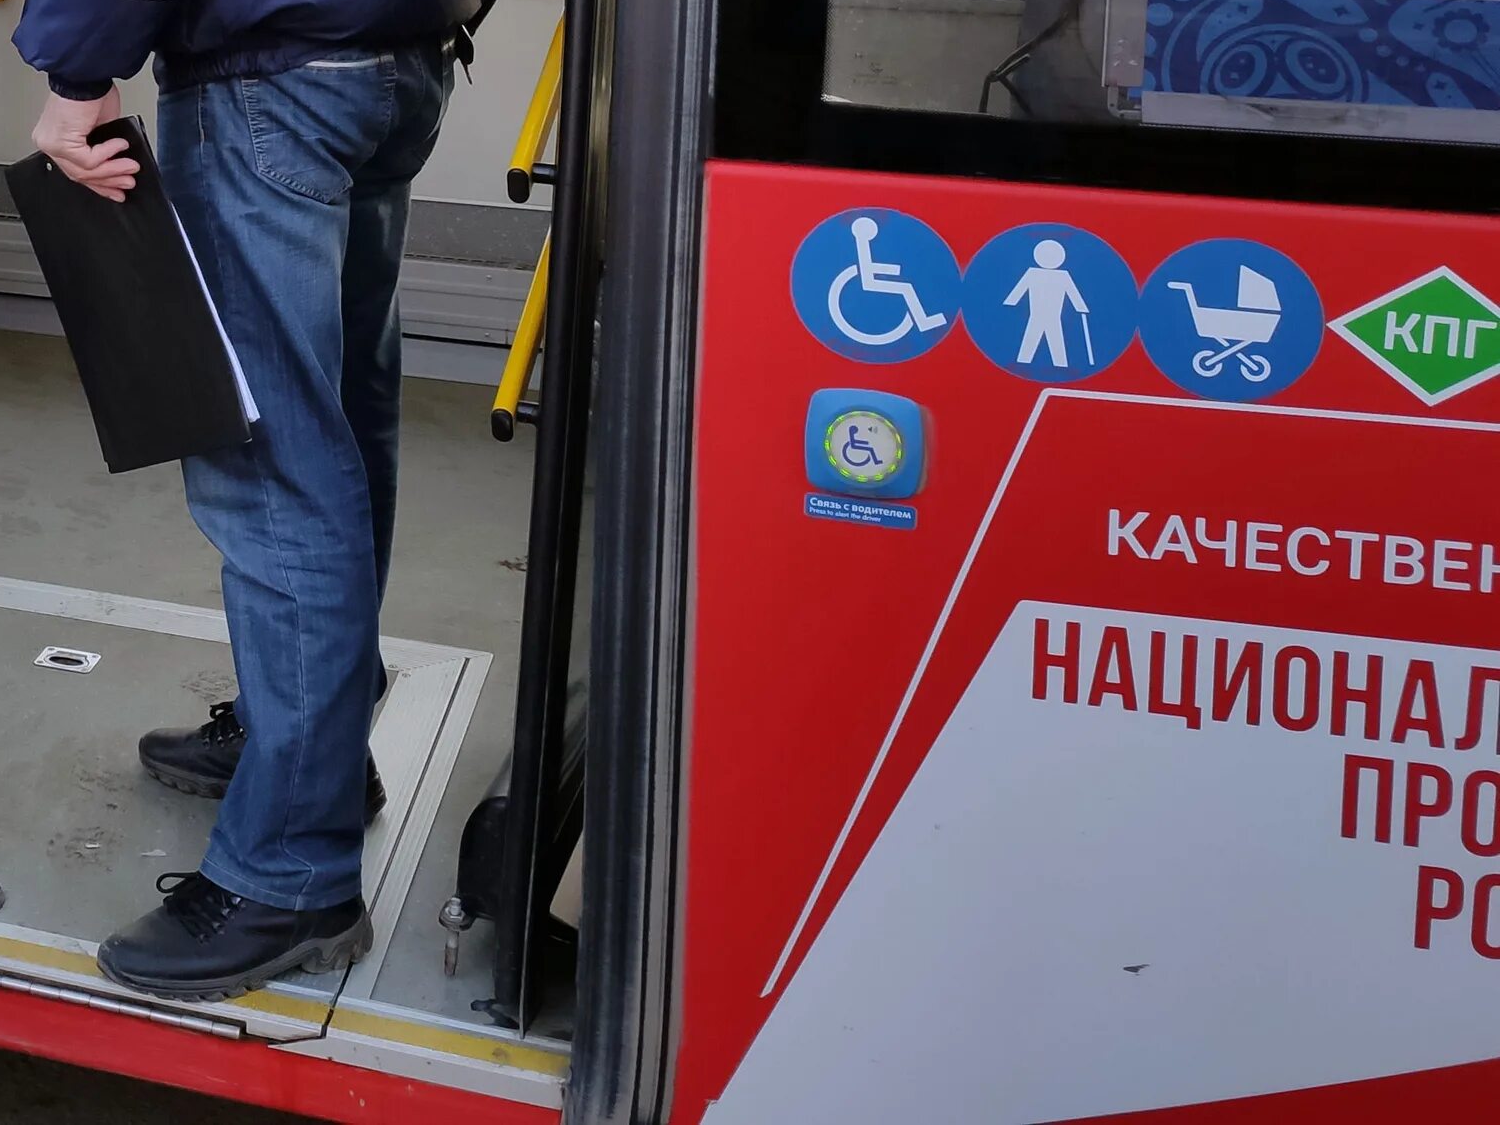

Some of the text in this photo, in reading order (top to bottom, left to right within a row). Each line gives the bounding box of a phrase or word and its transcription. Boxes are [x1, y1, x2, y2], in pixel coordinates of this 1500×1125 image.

[1383, 310, 1498, 360] КПГ
[808, 496, 842, 511] Связь
[851, 504, 912, 520] водителем
[1031, 617, 1500, 756] НАЦИОНАЛ
[1340, 752, 1500, 858] ПРО
